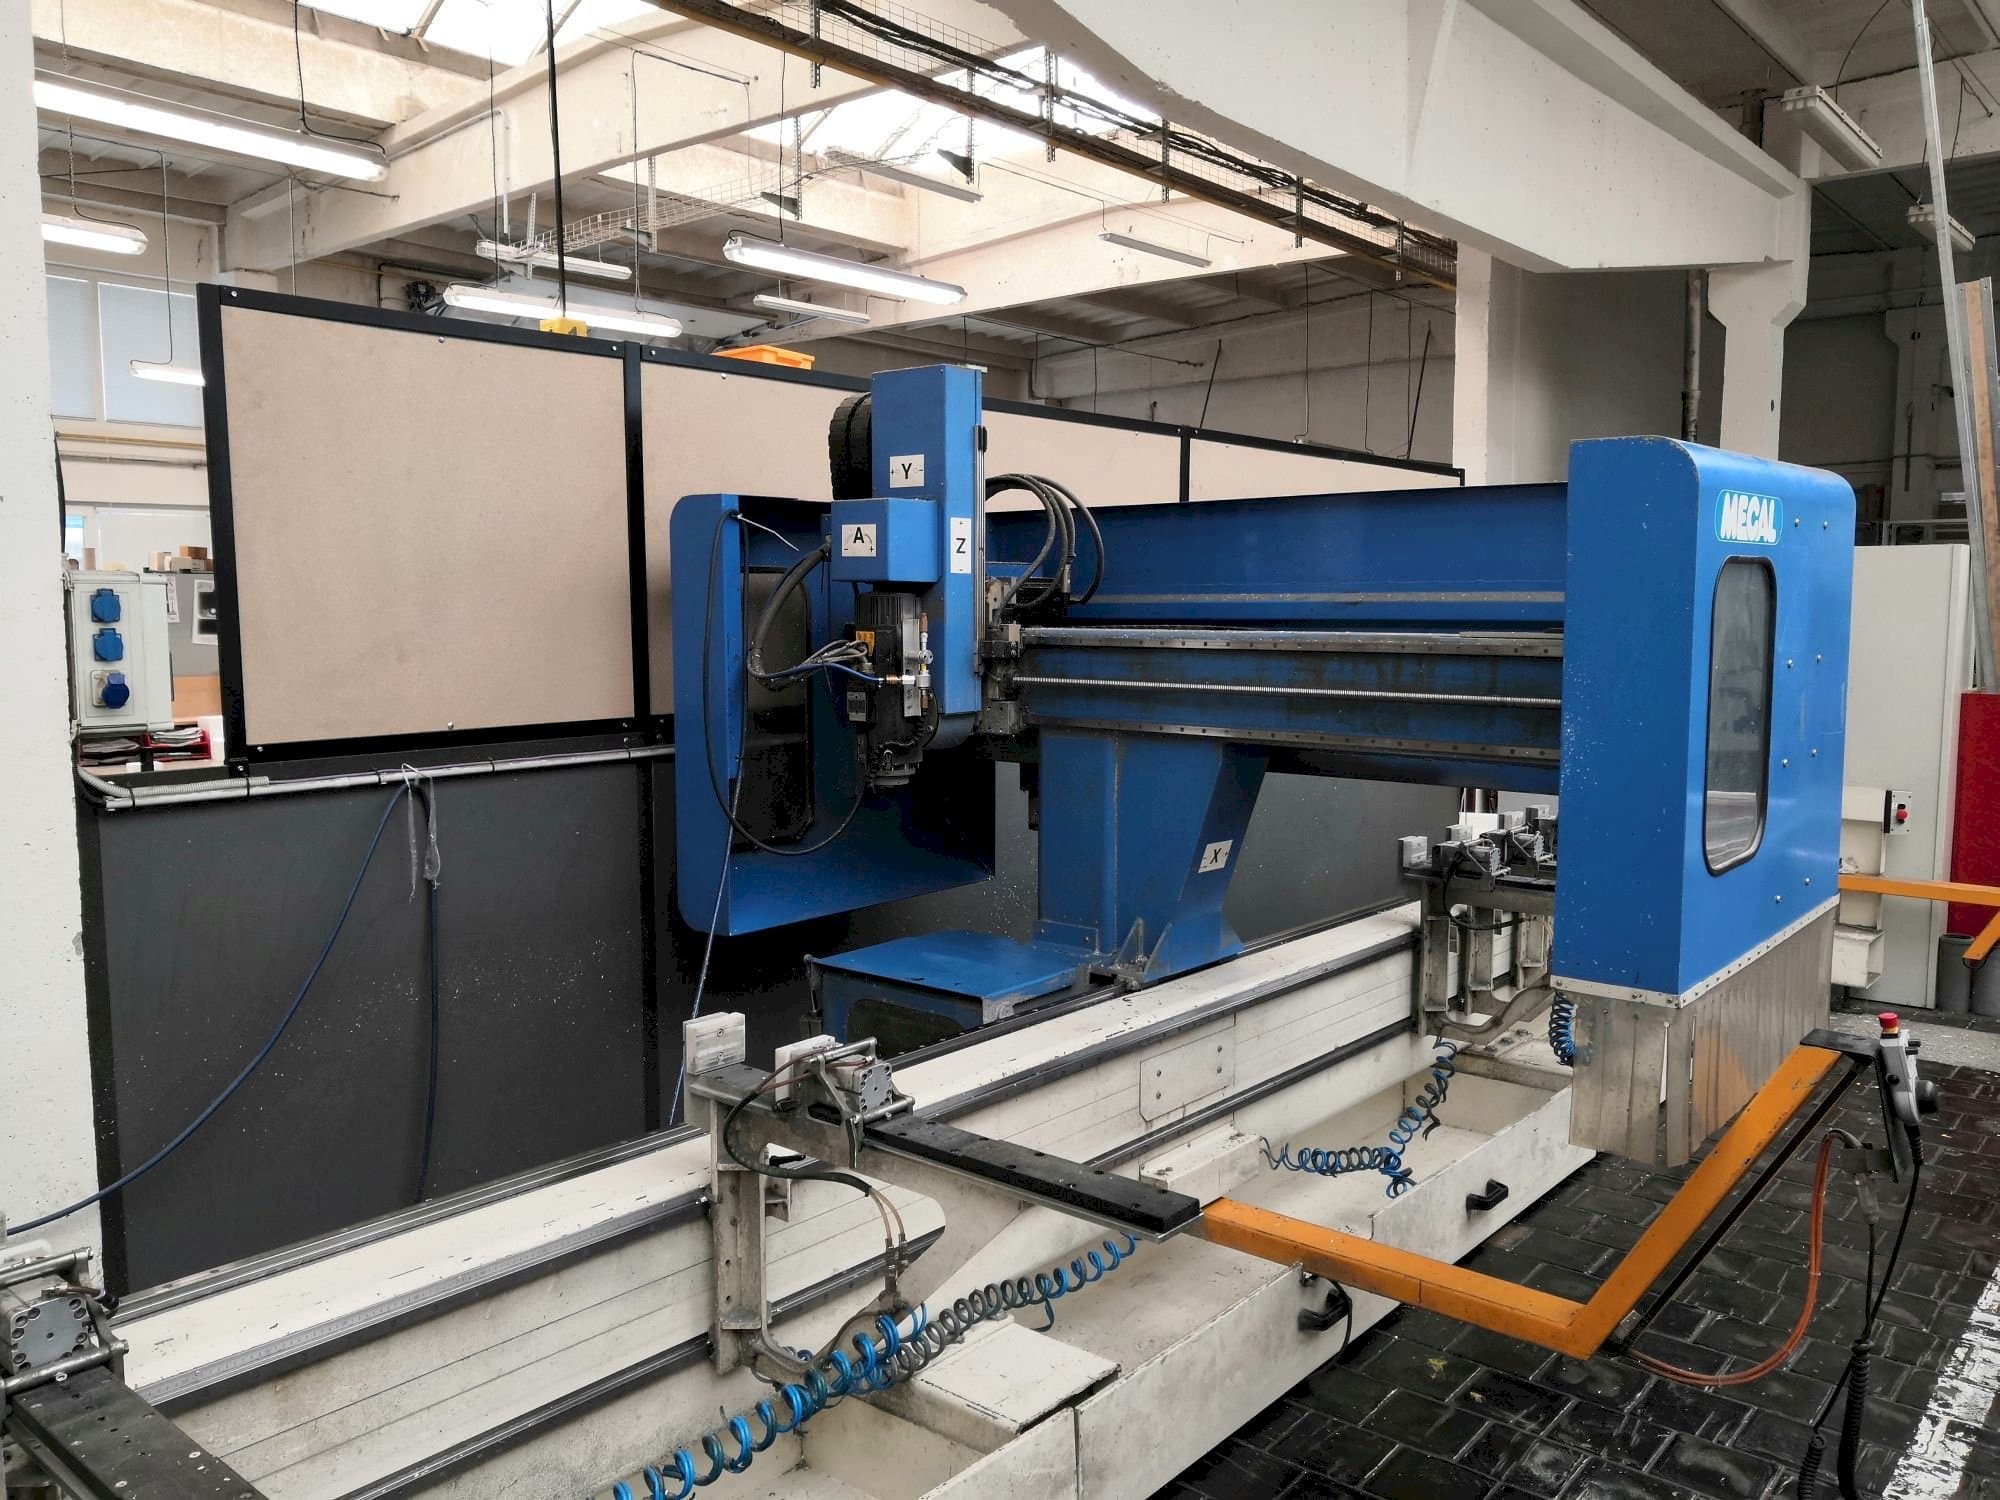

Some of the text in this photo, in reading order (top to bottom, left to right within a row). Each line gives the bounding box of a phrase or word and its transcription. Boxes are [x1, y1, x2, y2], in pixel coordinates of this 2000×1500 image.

[901, 462, 913, 480] Y
[1720, 492, 1777, 543] MECAL
[852, 526, 865, 544] A
[955, 537, 966, 554] Z
[1209, 847, 1222, 865] X
